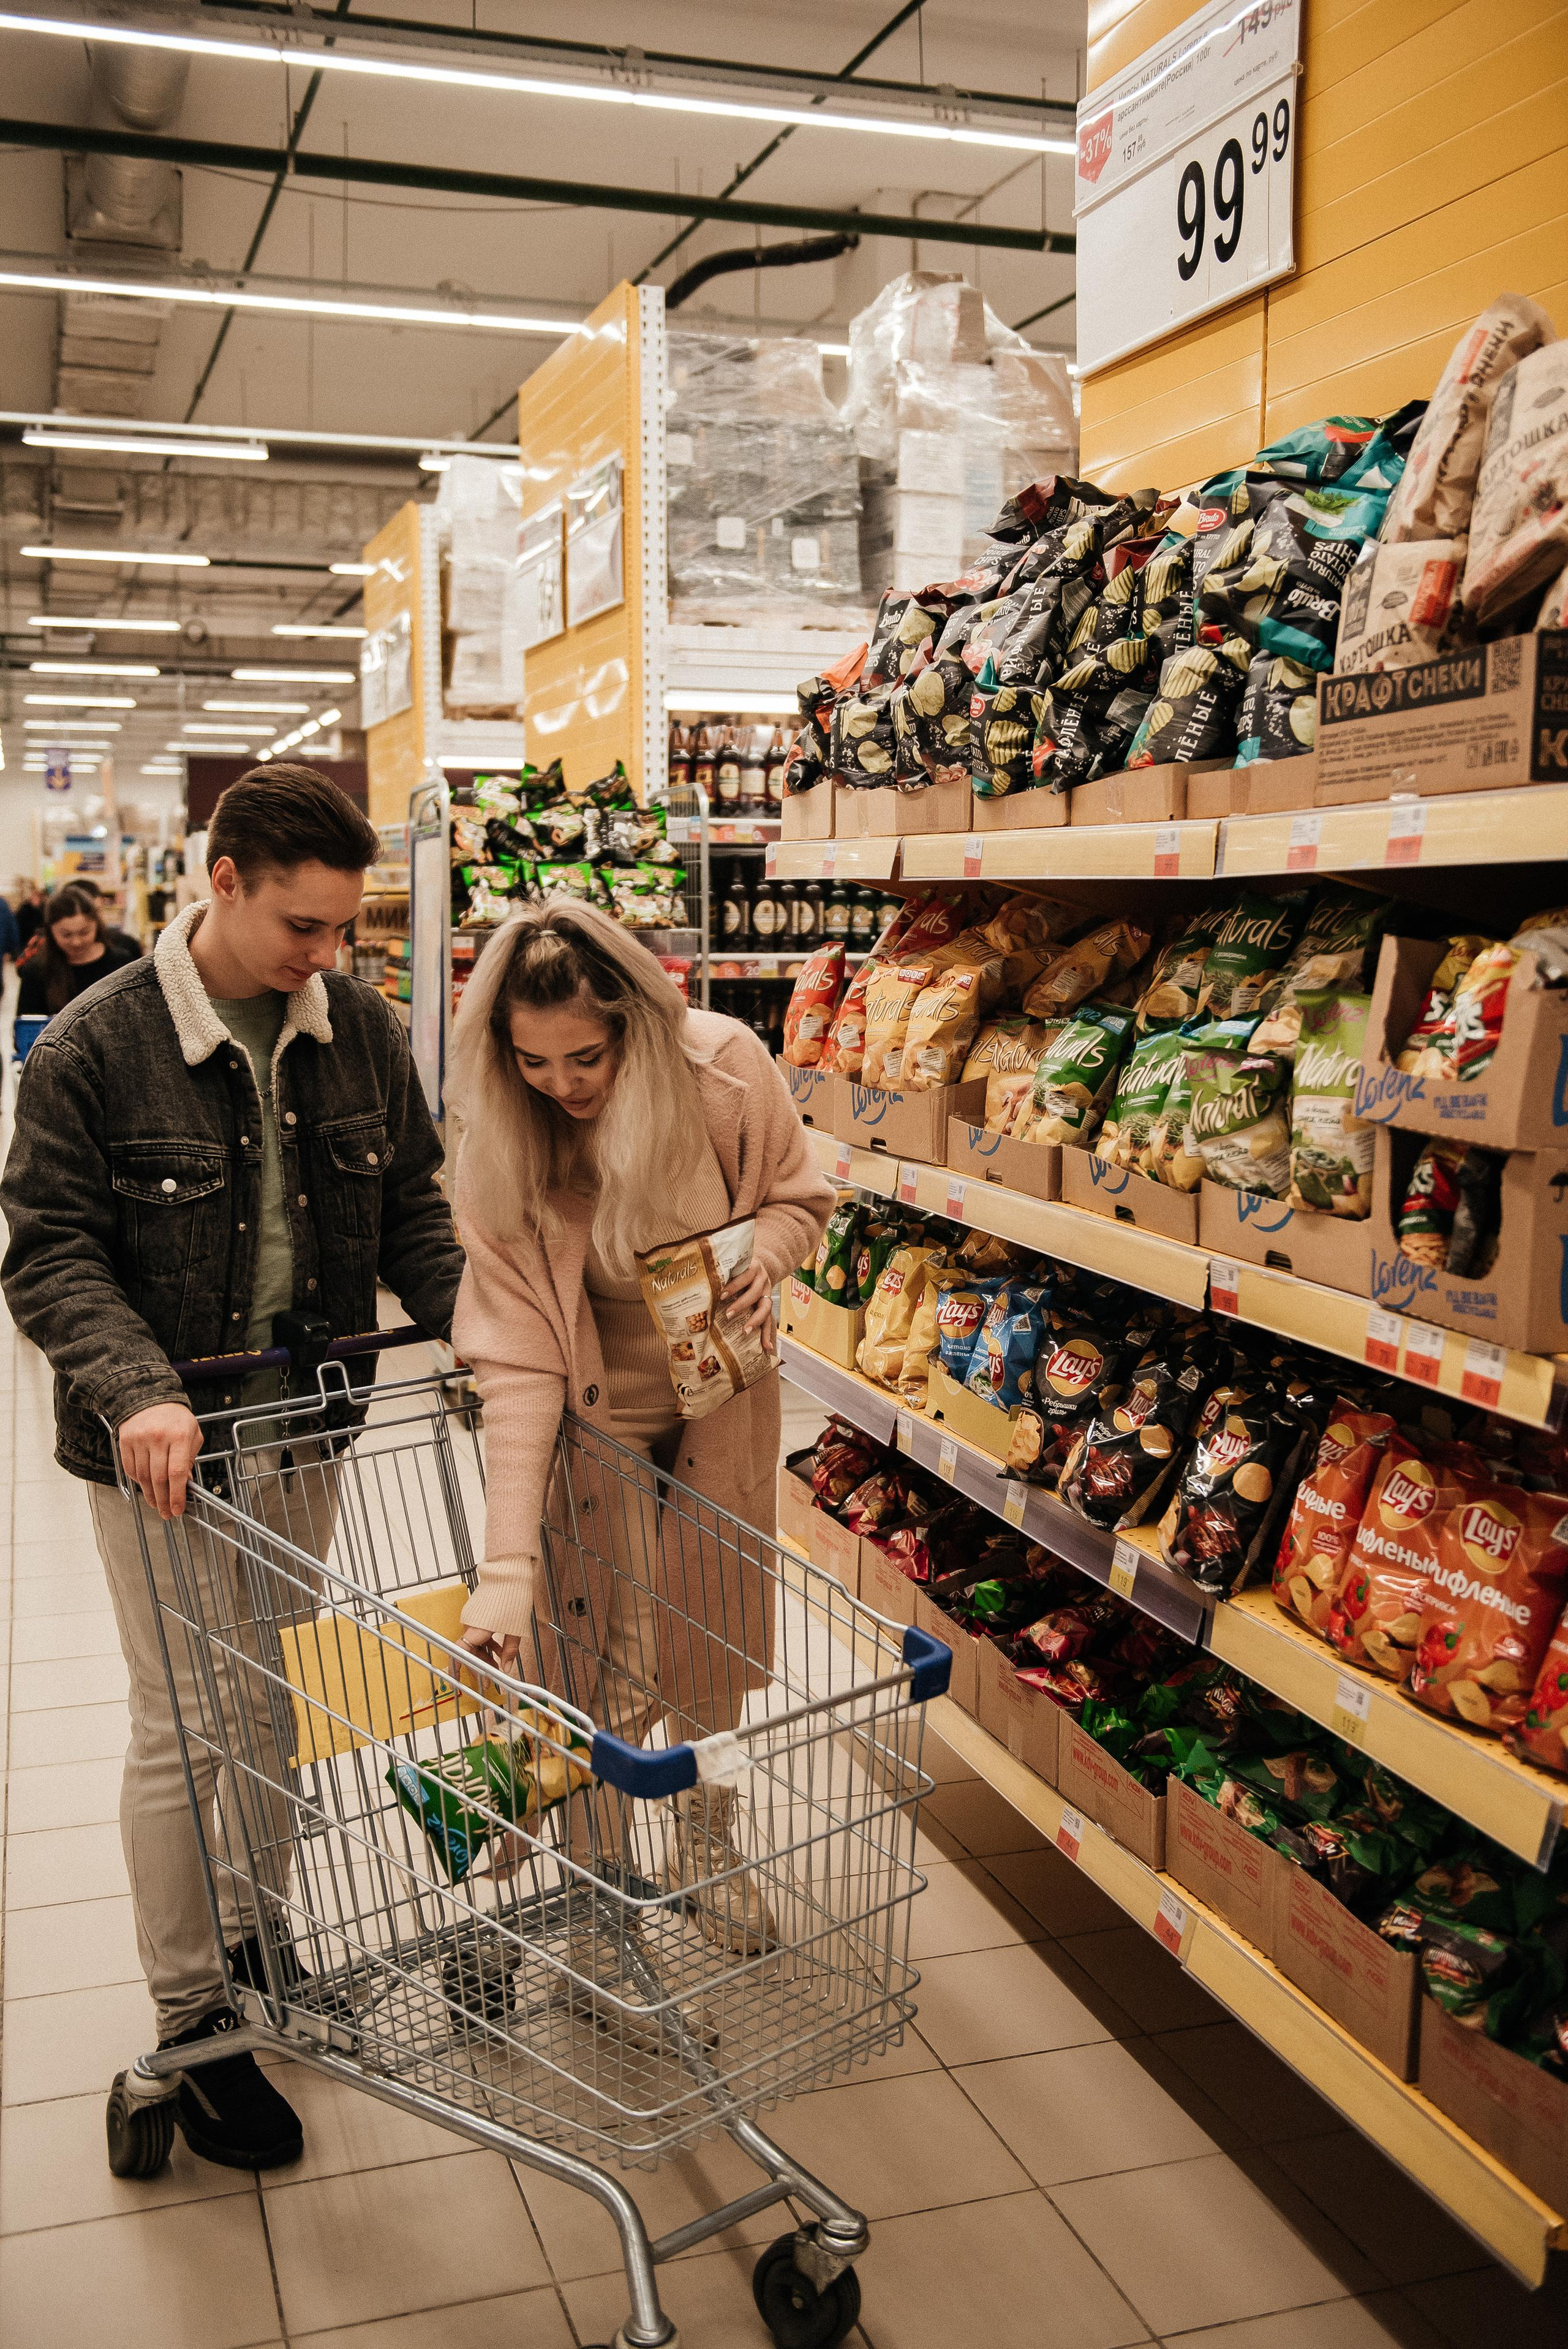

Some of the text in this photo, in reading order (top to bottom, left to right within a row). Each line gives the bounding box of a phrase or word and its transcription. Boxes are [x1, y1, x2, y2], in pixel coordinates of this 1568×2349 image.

[1140, 52, 1177, 86] NATURALS
[1234, 72, 1245, 86] цена
[1246, 69, 1252, 78] по
[1080, 124, 1112, 164] -37%
[1119, 131, 1128, 140] цена
[1122, 141, 1137, 163] 157
[1137, 134, 1144, 143] 89
[1137, 138, 1146, 153] руб
[1251, 98, 1290, 175] 99
[1177, 138, 1245, 282] 99
[1325, 657, 1482, 719] КРАФТ СНЕКИ
[1175, 690, 1218, 763] ЛЁНЫЕ
[651, 1259, 698, 1294] Naturals
[938, 1299, 982, 1328] Lay's
[1049, 1351, 1100, 1385] Lay's
[1042, 1397, 1078, 1410] «Ребрышки
[1381, 1472, 1433, 1514] Lay's
[1464, 1508, 1518, 1557] Lay's
